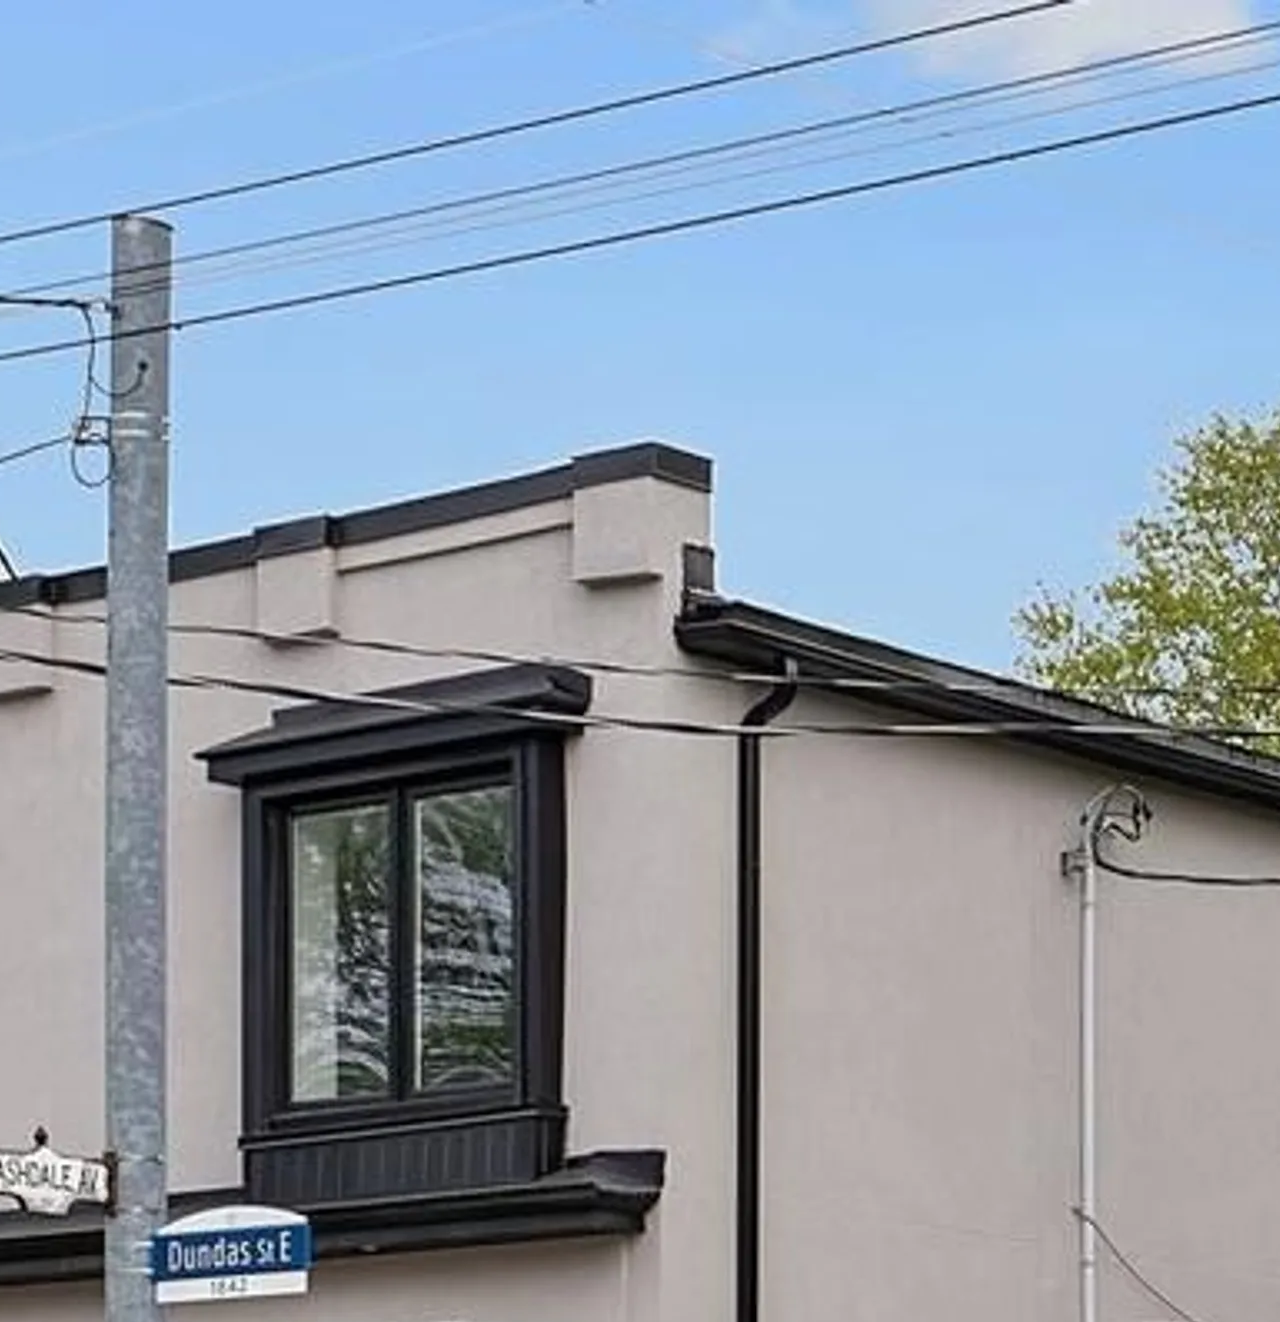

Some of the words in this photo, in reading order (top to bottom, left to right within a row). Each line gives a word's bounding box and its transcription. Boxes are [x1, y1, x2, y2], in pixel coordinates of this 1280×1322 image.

[167, 1234, 252, 1273] Dundas
[257, 1238, 275, 1264] St
[280, 1230, 292, 1263] E
